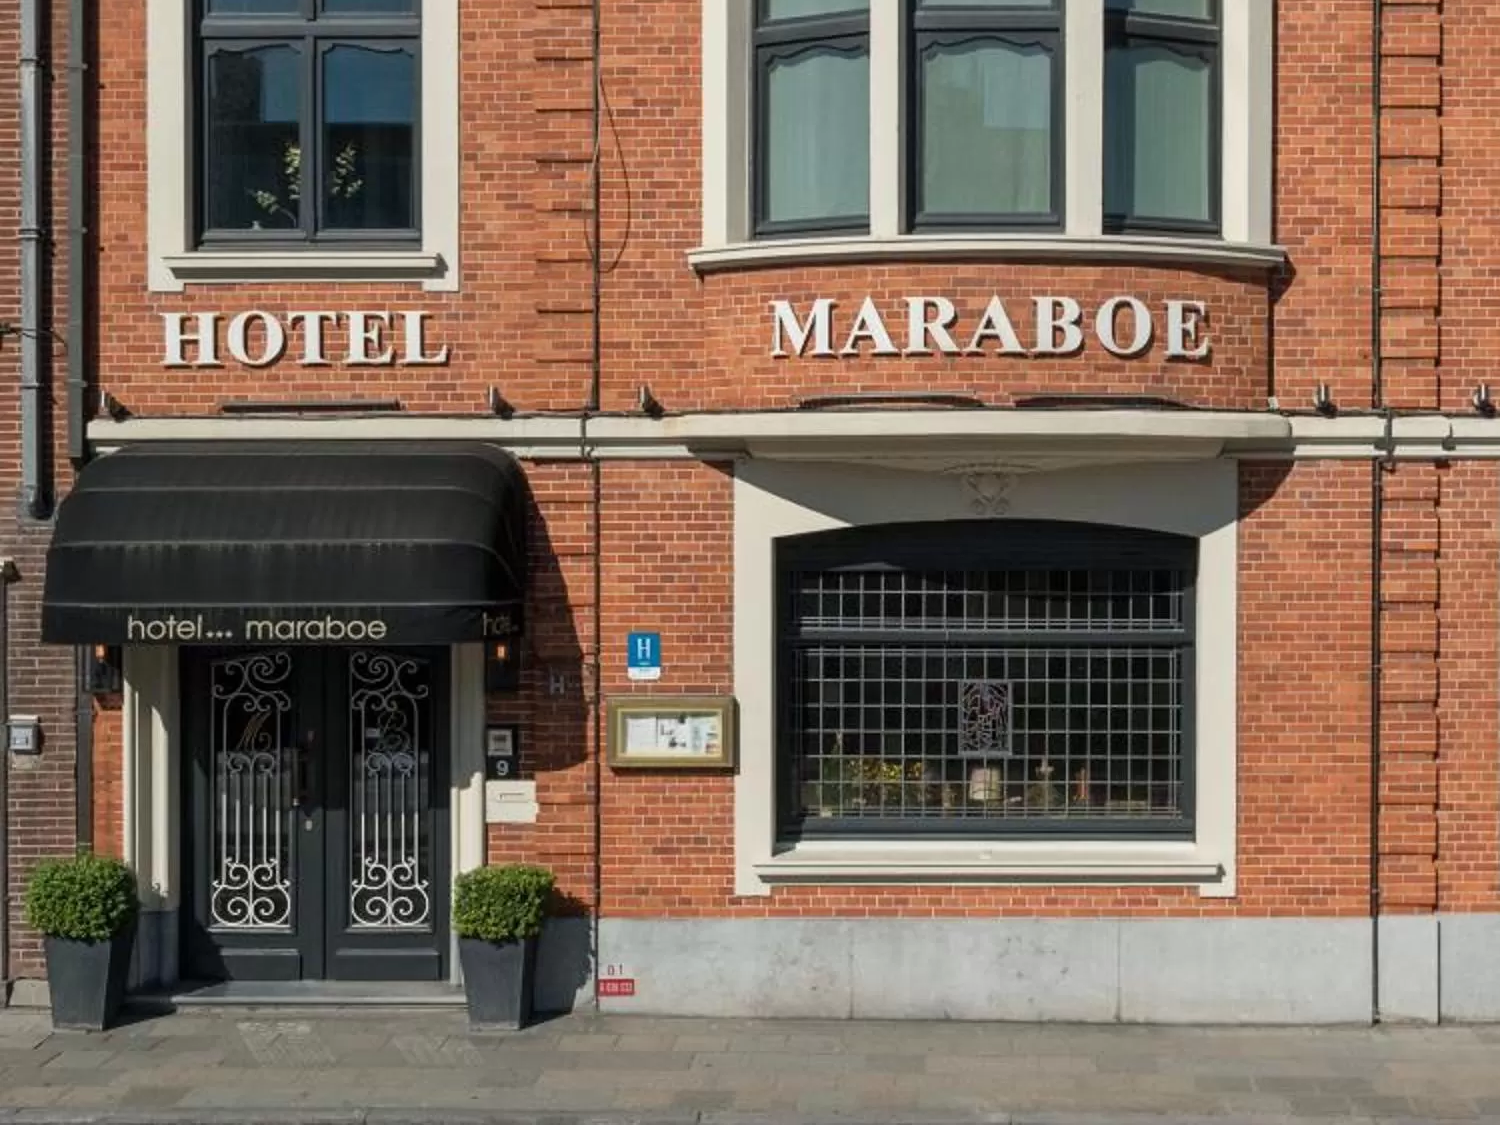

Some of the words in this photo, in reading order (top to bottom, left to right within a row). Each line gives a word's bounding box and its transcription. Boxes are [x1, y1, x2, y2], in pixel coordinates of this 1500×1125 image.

[160, 310, 450, 367] HOTEL
[770, 295, 1210, 357] MARABOE
[245, 615, 387, 641] maraboe
[637, 638, 650, 659] H
[496, 759, 509, 776] 9
